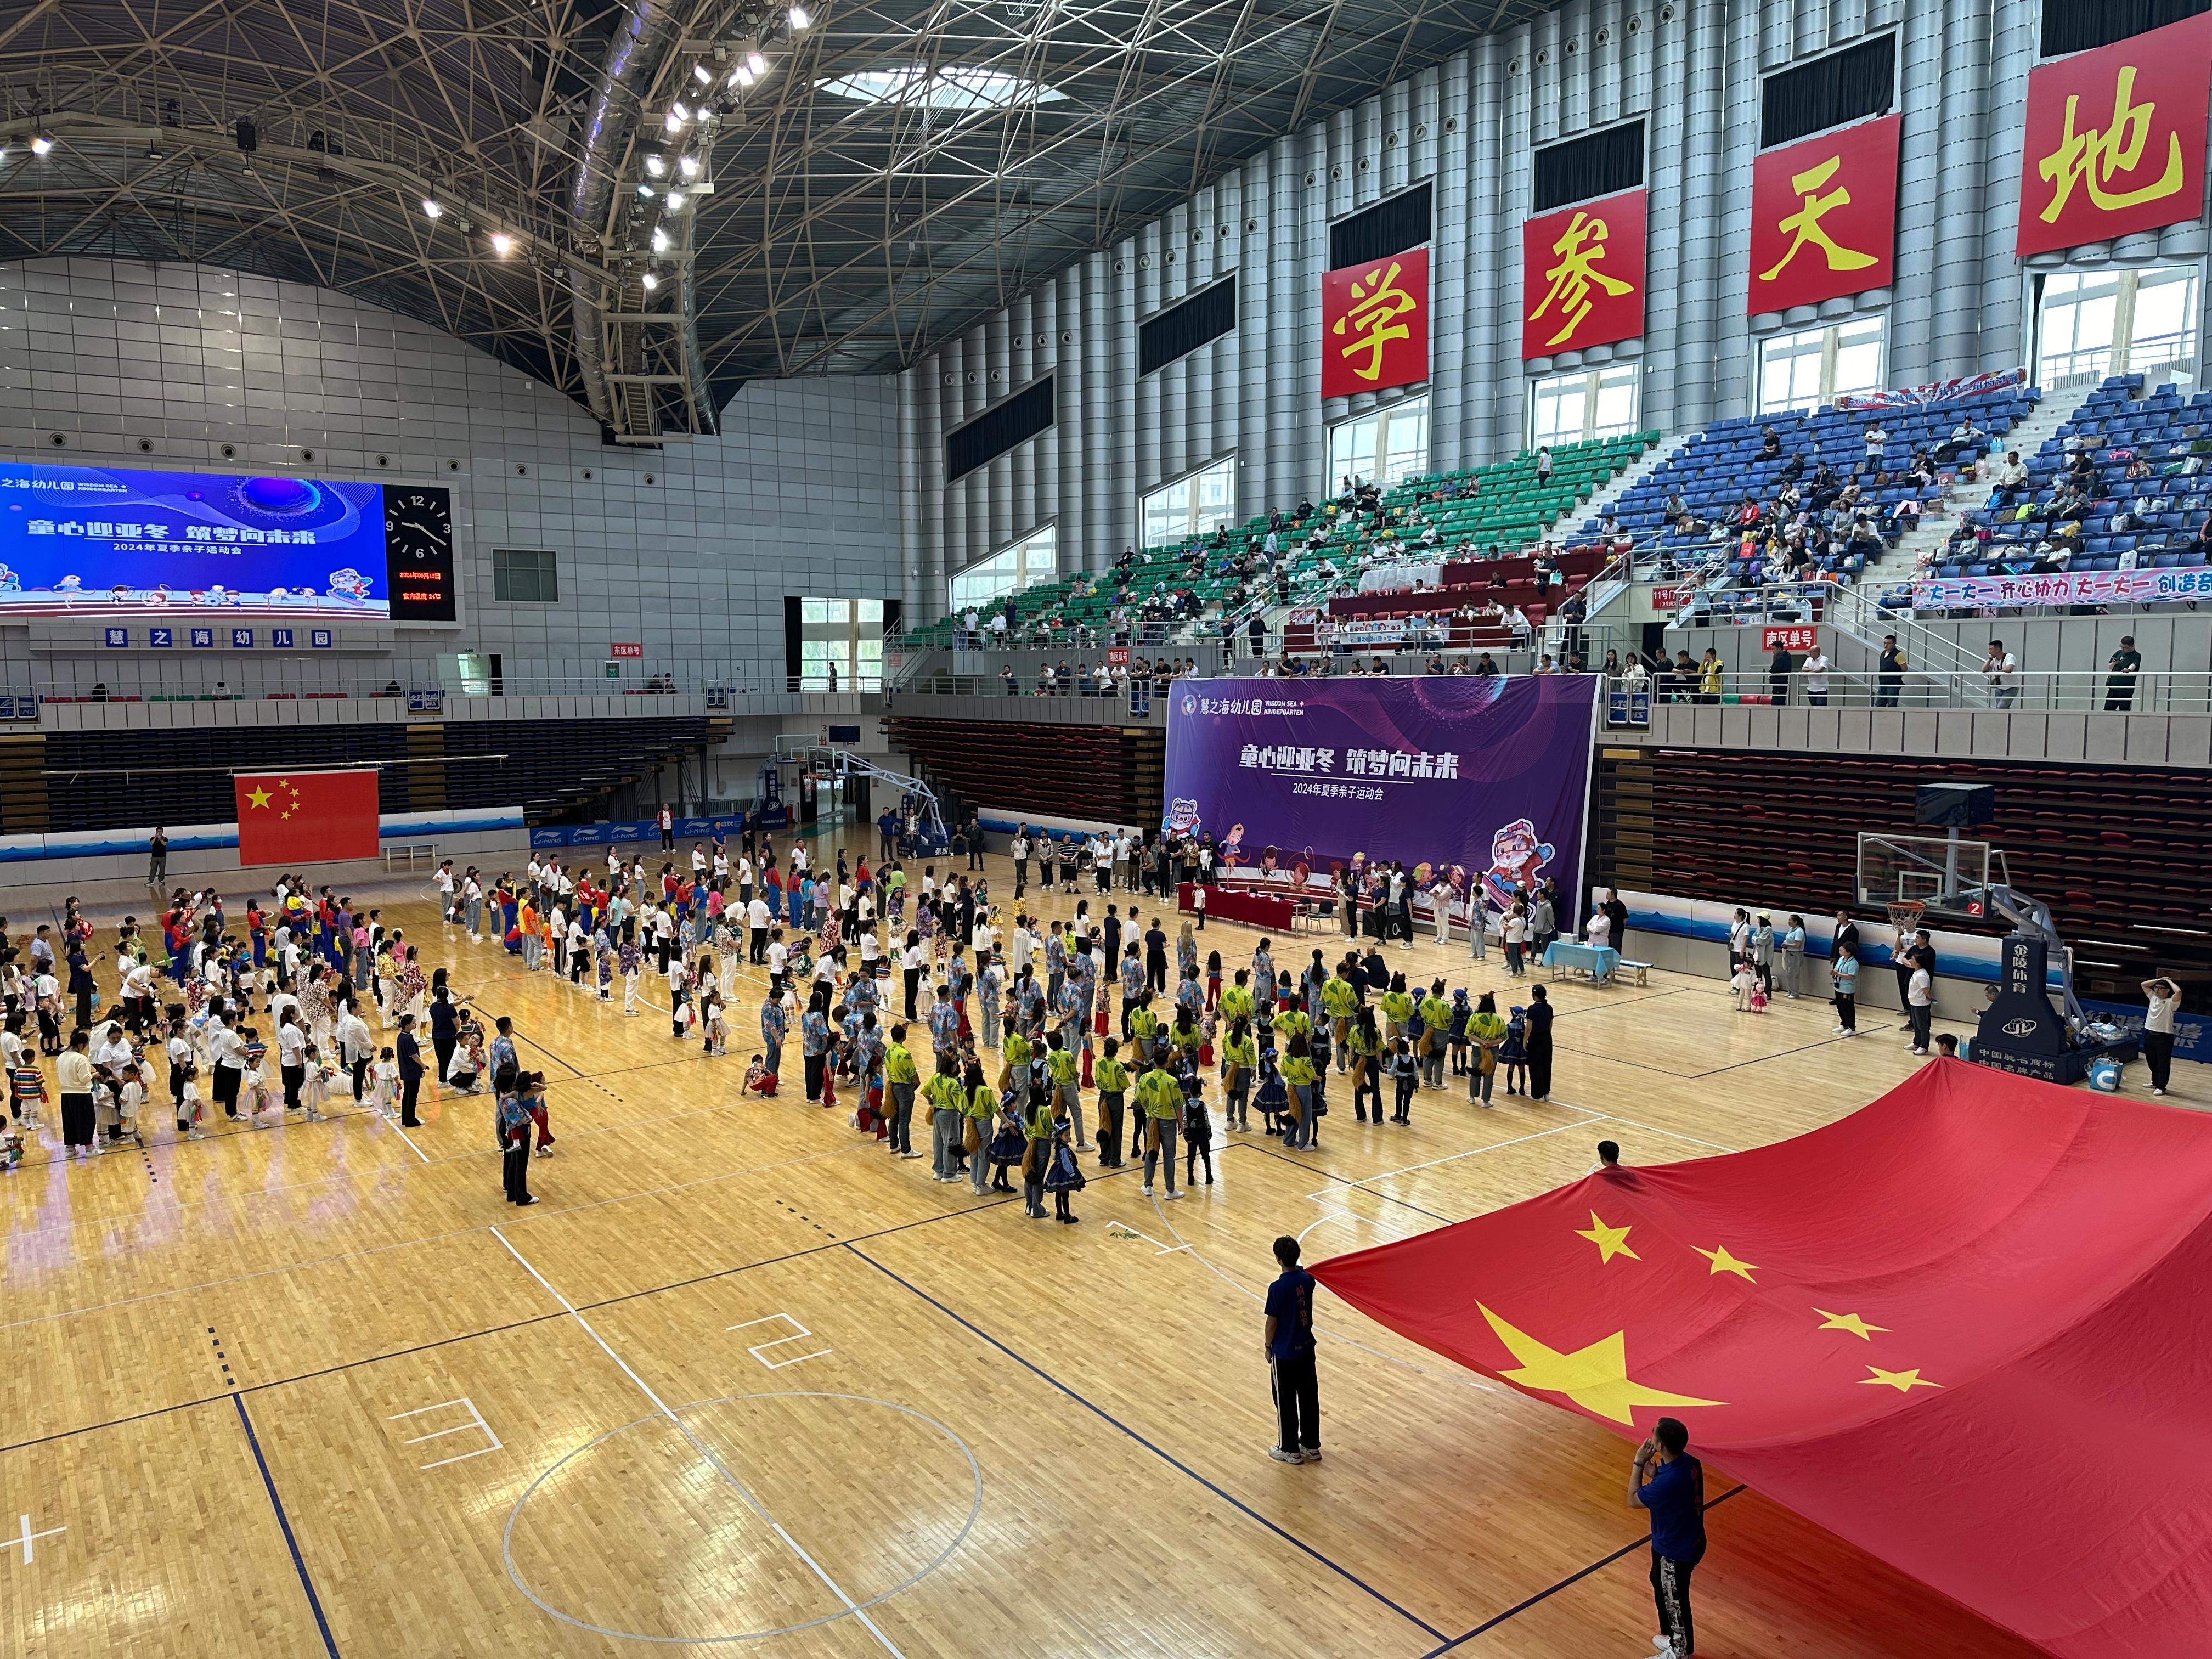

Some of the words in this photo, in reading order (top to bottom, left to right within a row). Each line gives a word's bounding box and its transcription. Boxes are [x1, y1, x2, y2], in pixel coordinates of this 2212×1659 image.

[1333, 263, 1416, 380] 学
[1528, 212, 1633, 346] 参
[1759, 156, 1878, 281] 天
[2039, 66, 2183, 223] 地
[410, 495, 425, 506] 12
[27, 520, 170, 539] 童心迎亚冬
[186, 525, 316, 545] 筑梦向未来
[386, 521, 394, 531] 9
[443, 523, 451, 533] 3
[113, 543, 242, 555] 2024年夏季亲子运动会
[416, 548, 425, 558] 6
[2000, 579, 2069, 599] 齐心协力
[109, 630, 328, 645] 慧之海幼儿园
[1766, 630, 1813, 647] 南区单号
[614, 646, 640, 656] 东区单号
[1109, 651, 1128, 662] 南区双号
[1200, 698, 1262, 716] 慧之海幼儿园
[1239, 743, 1335, 772] 童心迎亚冬
[1345, 748, 1459, 780] 筑梦向未来
[1292, 782, 1384, 801] 2024年夏季亲子运动会
[1971, 903, 1979, 914] 2
[2012, 944, 2029, 994] 金陵体育
[1979, 1048, 2056, 1069] 中国驰名商标
[1979, 1059, 2054, 1080] 中国名牌产品
